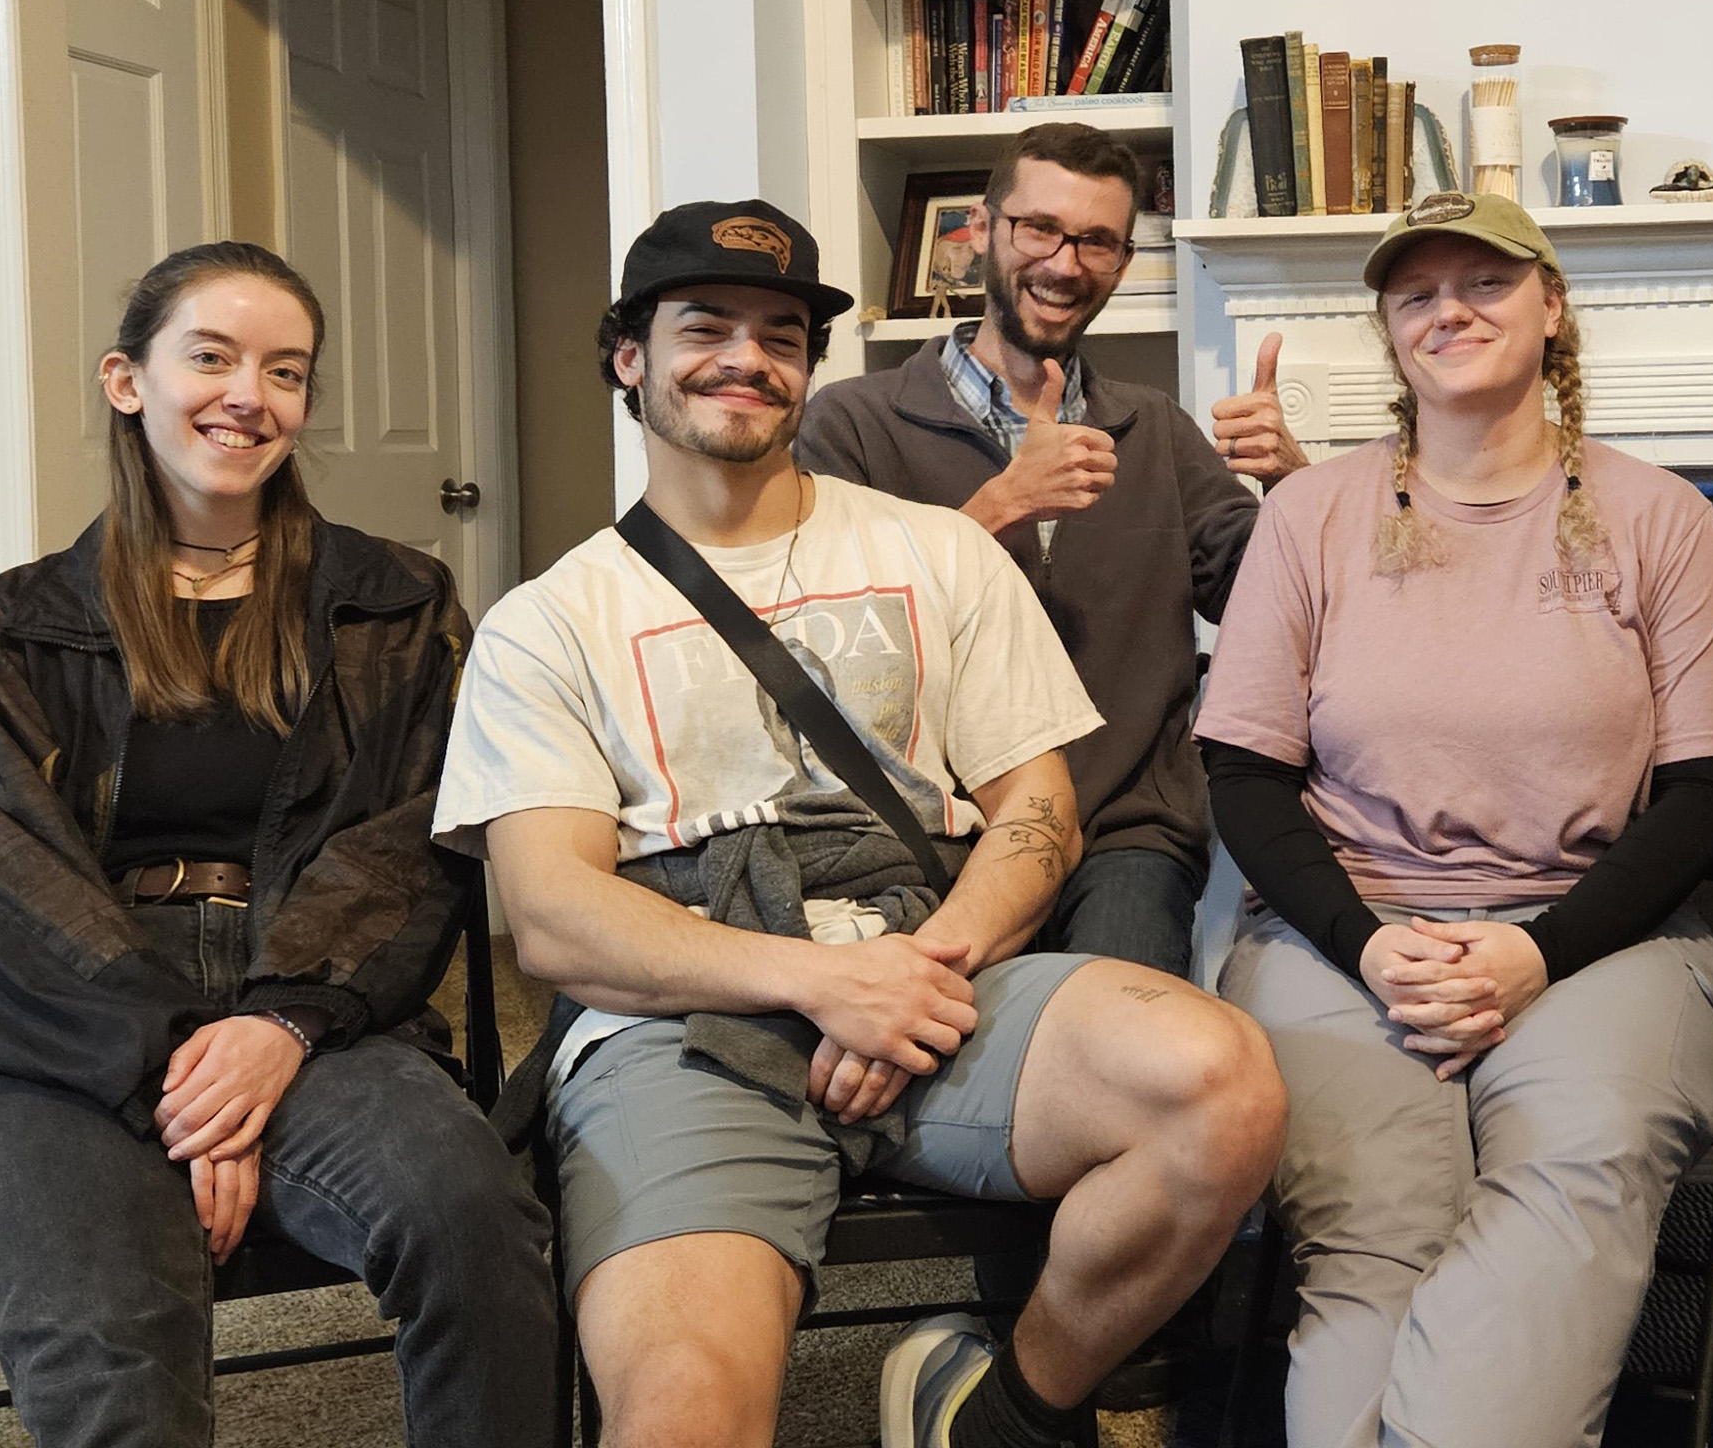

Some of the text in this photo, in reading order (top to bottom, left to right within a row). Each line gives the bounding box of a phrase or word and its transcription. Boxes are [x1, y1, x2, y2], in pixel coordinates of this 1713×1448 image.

[1034, 28, 1042, 46] OUR
[1080, 17, 1108, 69] AMERICA
[948, 42, 958, 66] With
[958, 41, 969, 79] Women
[1020, 53, 1027, 63] BY
[1032, 48, 1041, 70] WILD
[958, 78, 969, 102] Who
[1074, 97, 1100, 107] paleo
[1101, 95, 1145, 105] cookbook
[1573, 571, 1604, 593] PIER
